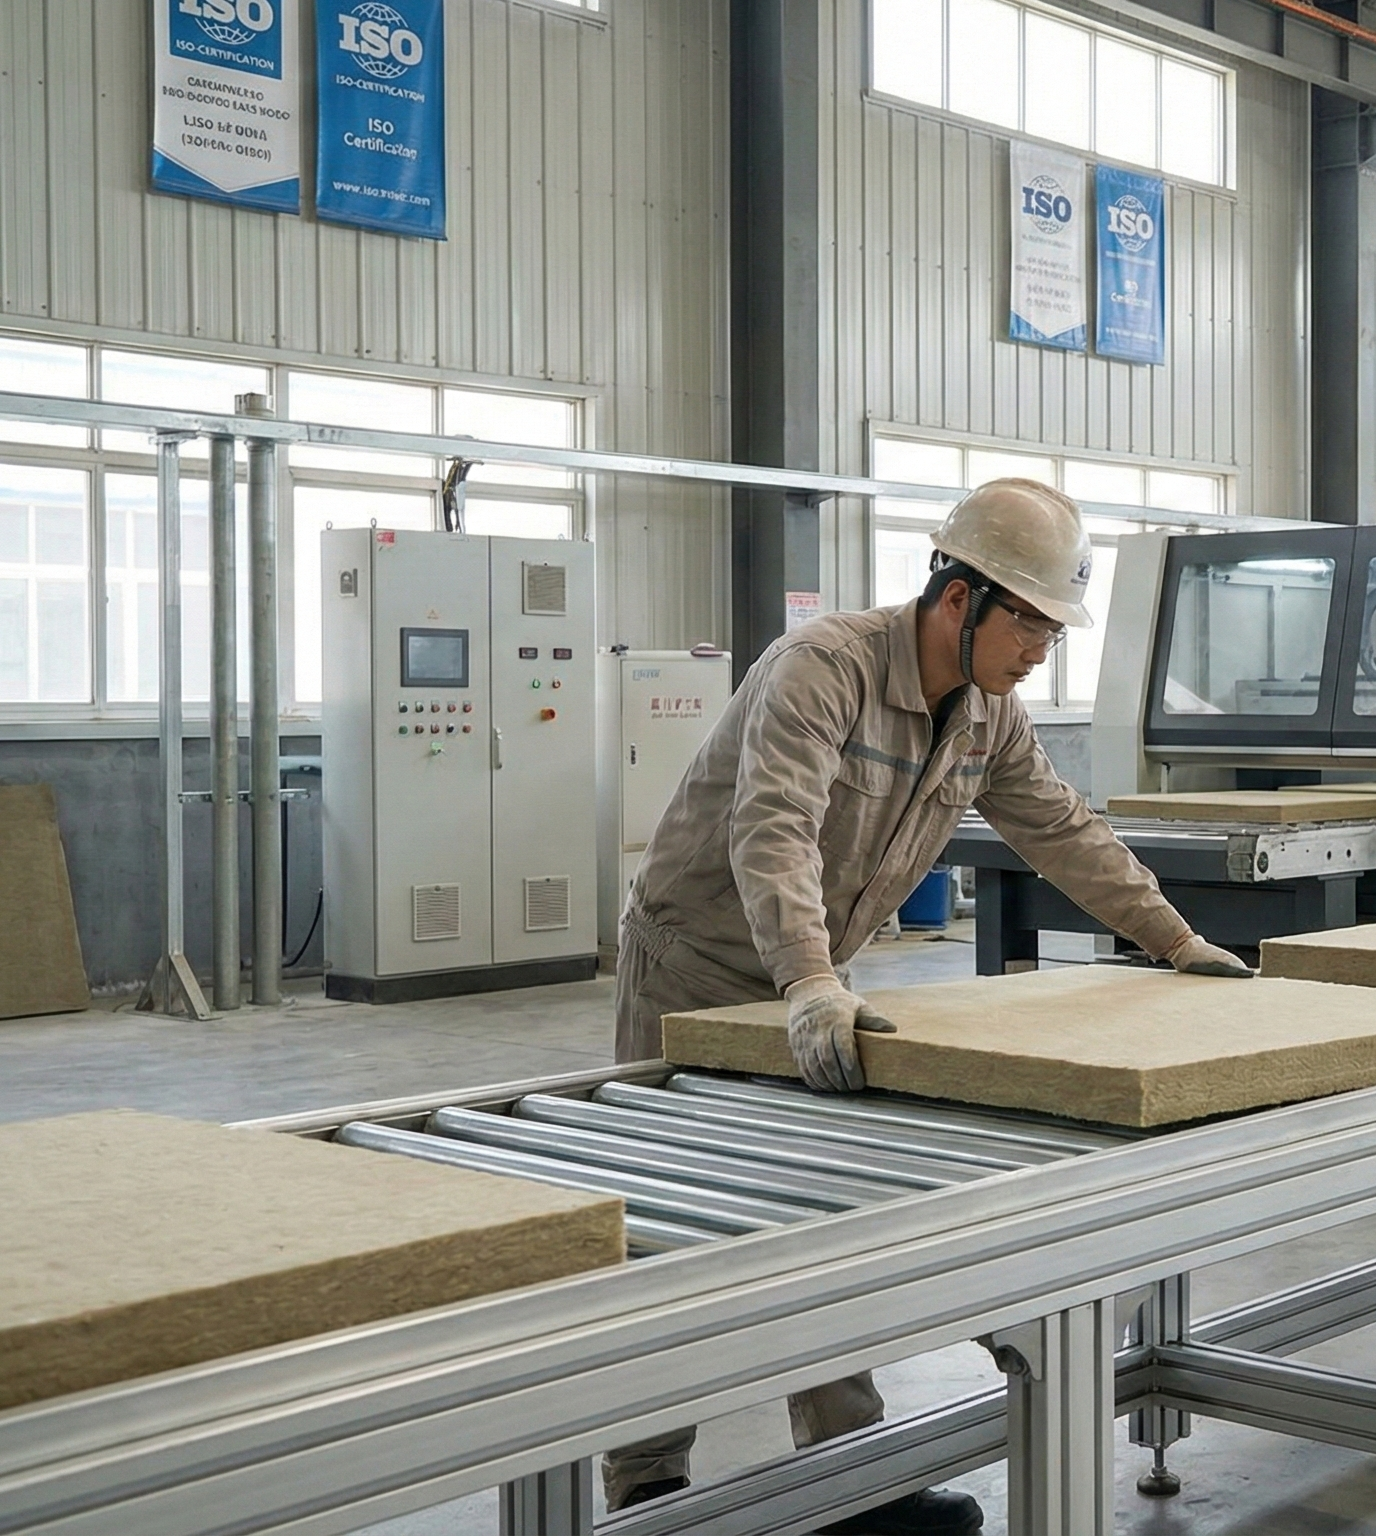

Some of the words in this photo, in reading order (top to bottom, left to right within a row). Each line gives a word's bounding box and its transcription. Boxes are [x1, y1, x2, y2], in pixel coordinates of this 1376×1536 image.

[338, 13, 424, 66] ISO
[368, 117, 394, 135] ISO
[1022, 186, 1072, 223] ISO
[1107, 205, 1154, 240] ISO
